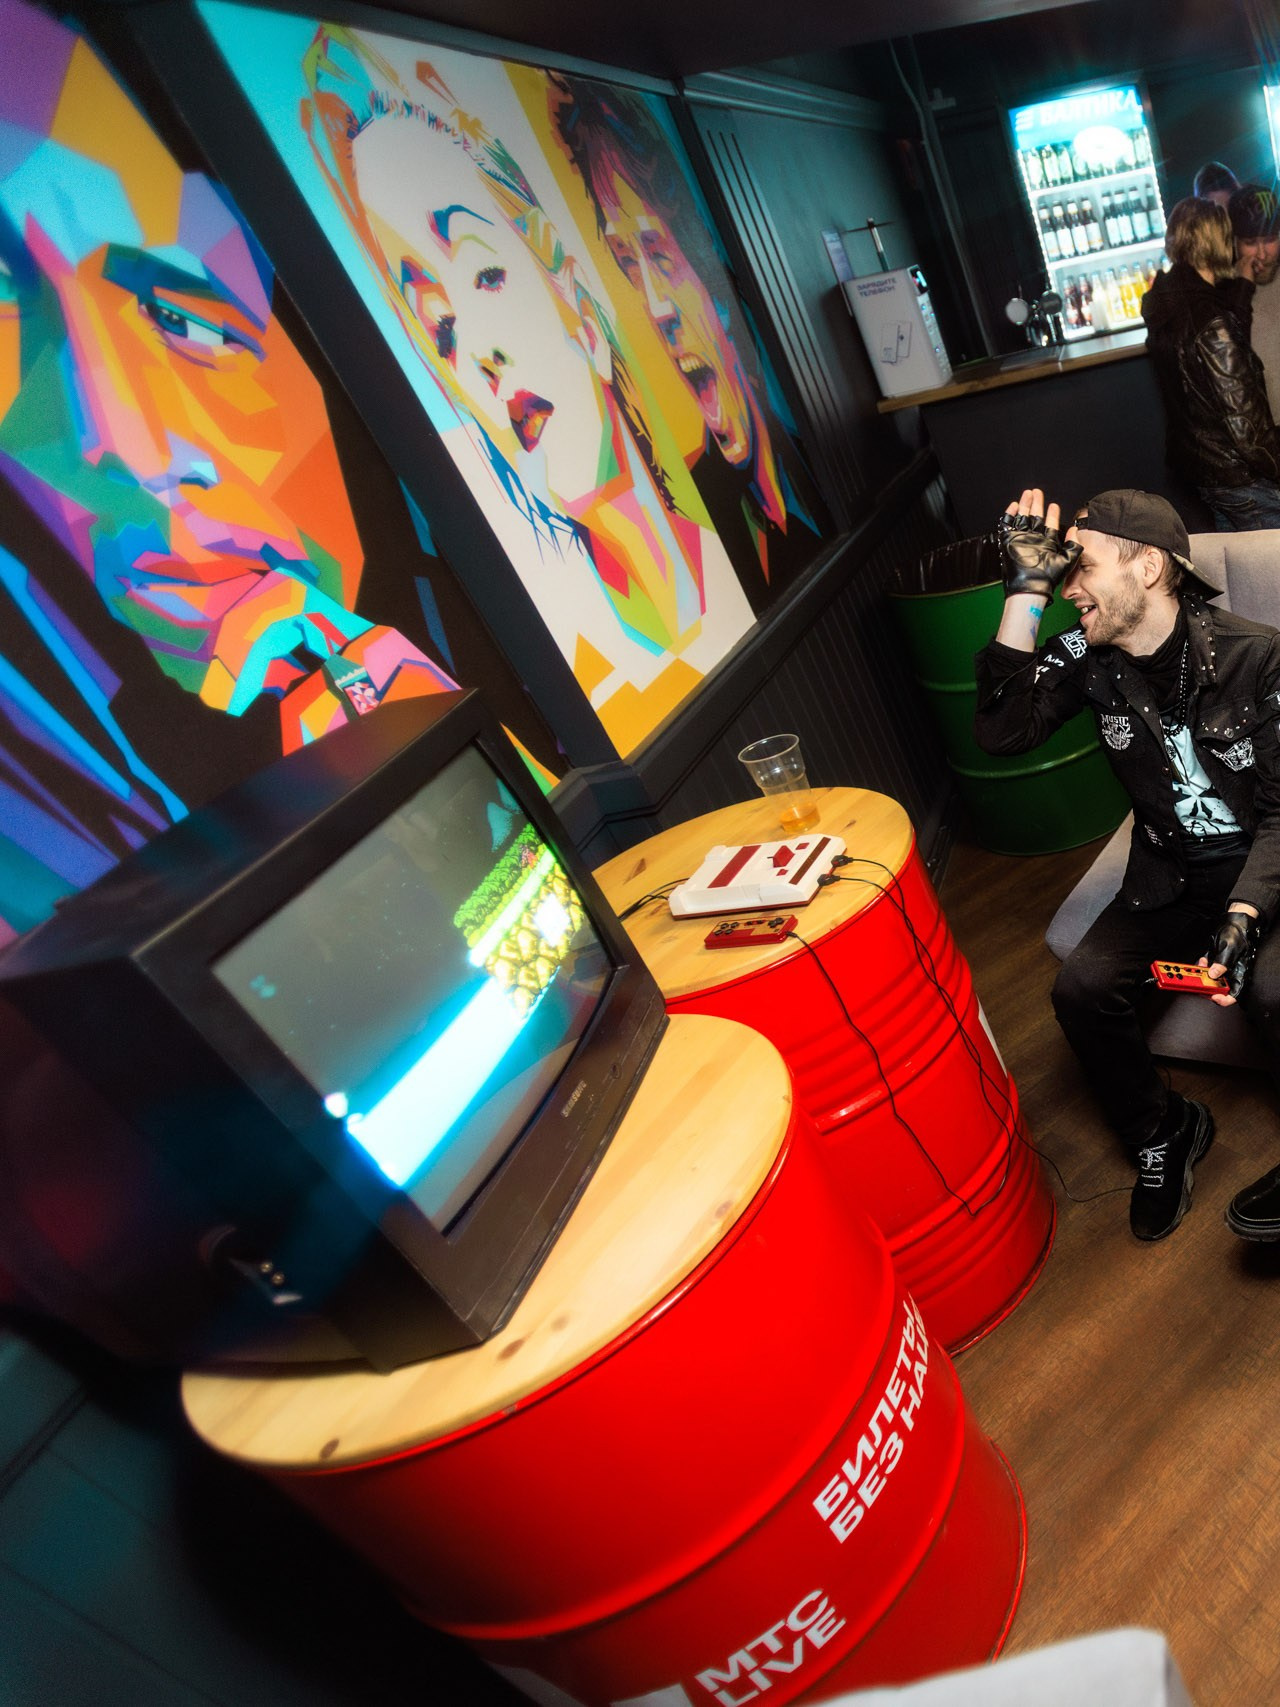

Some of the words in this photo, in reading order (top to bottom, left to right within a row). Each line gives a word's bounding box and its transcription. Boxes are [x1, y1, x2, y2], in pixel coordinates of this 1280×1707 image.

[1100, 713, 1129, 727] MUSIC
[561, 1080, 587, 1118] SAMSUNG
[812, 1299, 916, 1522] БИЛЕТЫ
[829, 1431, 904, 1544] БЕЗ
[694, 1588, 829, 1693] МТС
[714, 1606, 847, 1707] LIVE
